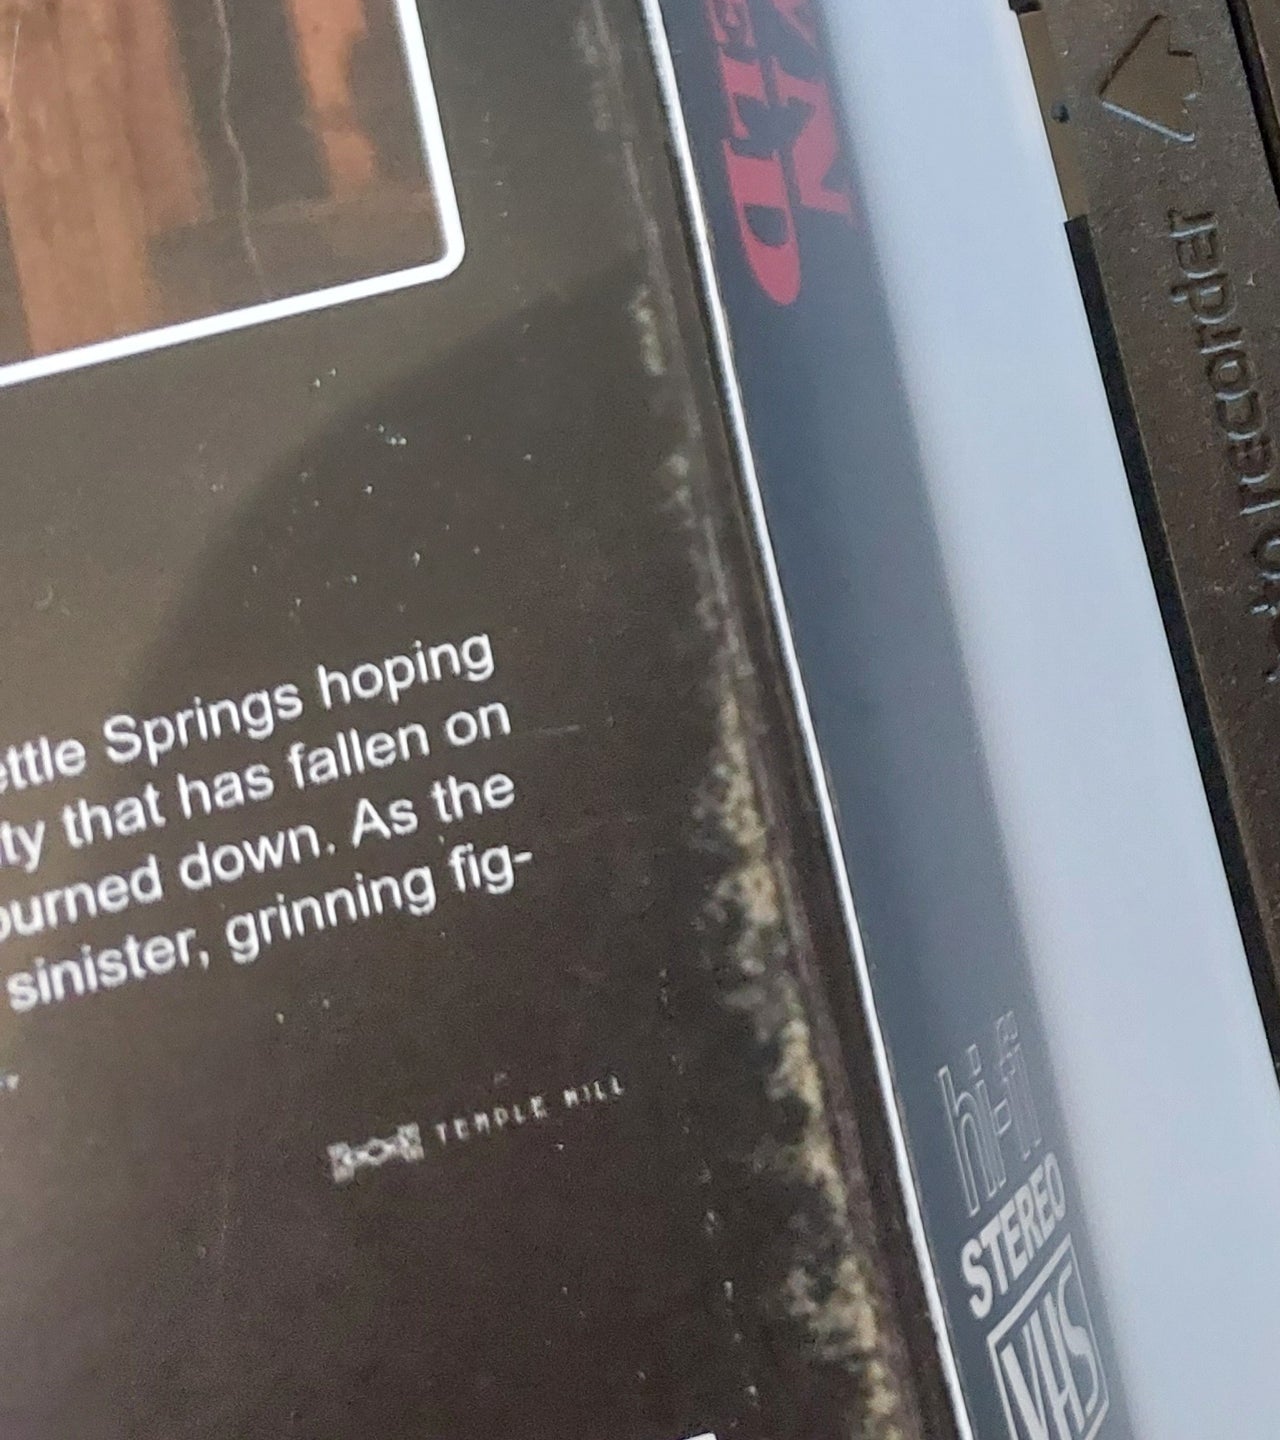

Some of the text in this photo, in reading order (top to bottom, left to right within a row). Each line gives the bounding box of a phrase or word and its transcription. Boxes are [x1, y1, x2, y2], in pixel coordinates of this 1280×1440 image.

[102, 683, 303, 767] Springs
[316, 633, 495, 710] hoping
[62, 782, 167, 849] that
[176, 762, 275, 820] has
[287, 728, 430, 790] fallen
[445, 701, 512, 747] on
[178, 823, 336, 891] down.
[352, 797, 418, 849] As
[430, 772, 515, 824] the
[6, 842, 533, 1013] sinister, grinning fig-
[435, 1095, 547, 1146] TEMPLE
[961, 1152, 1066, 1320] STEREO
[1000, 1259, 1098, 1440] VHS
